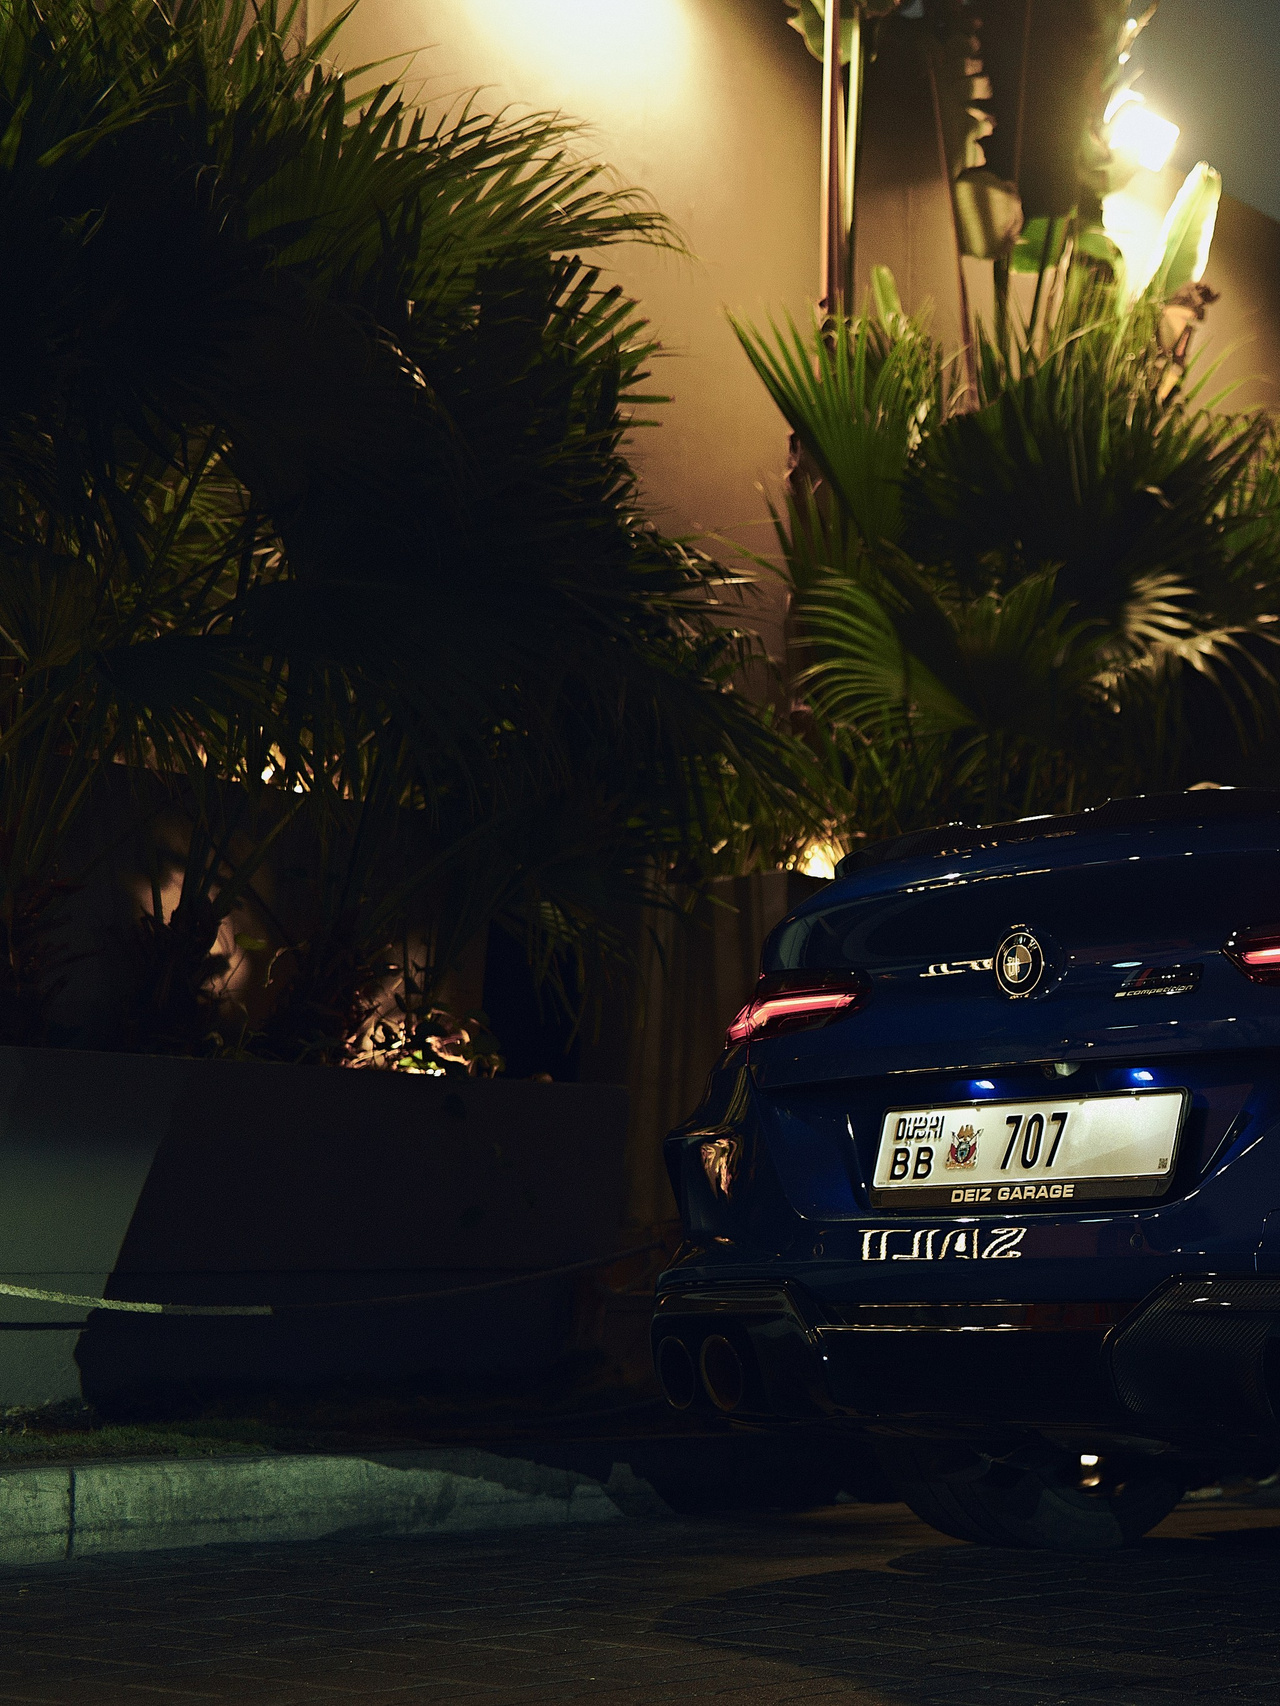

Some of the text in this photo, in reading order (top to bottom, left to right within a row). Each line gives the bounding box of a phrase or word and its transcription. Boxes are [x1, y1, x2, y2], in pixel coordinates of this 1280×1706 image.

[1000, 1111, 1068, 1170] 707
[889, 1146, 934, 1181] BB
[950, 1184, 1075, 1203] DEIZ GARAGE
